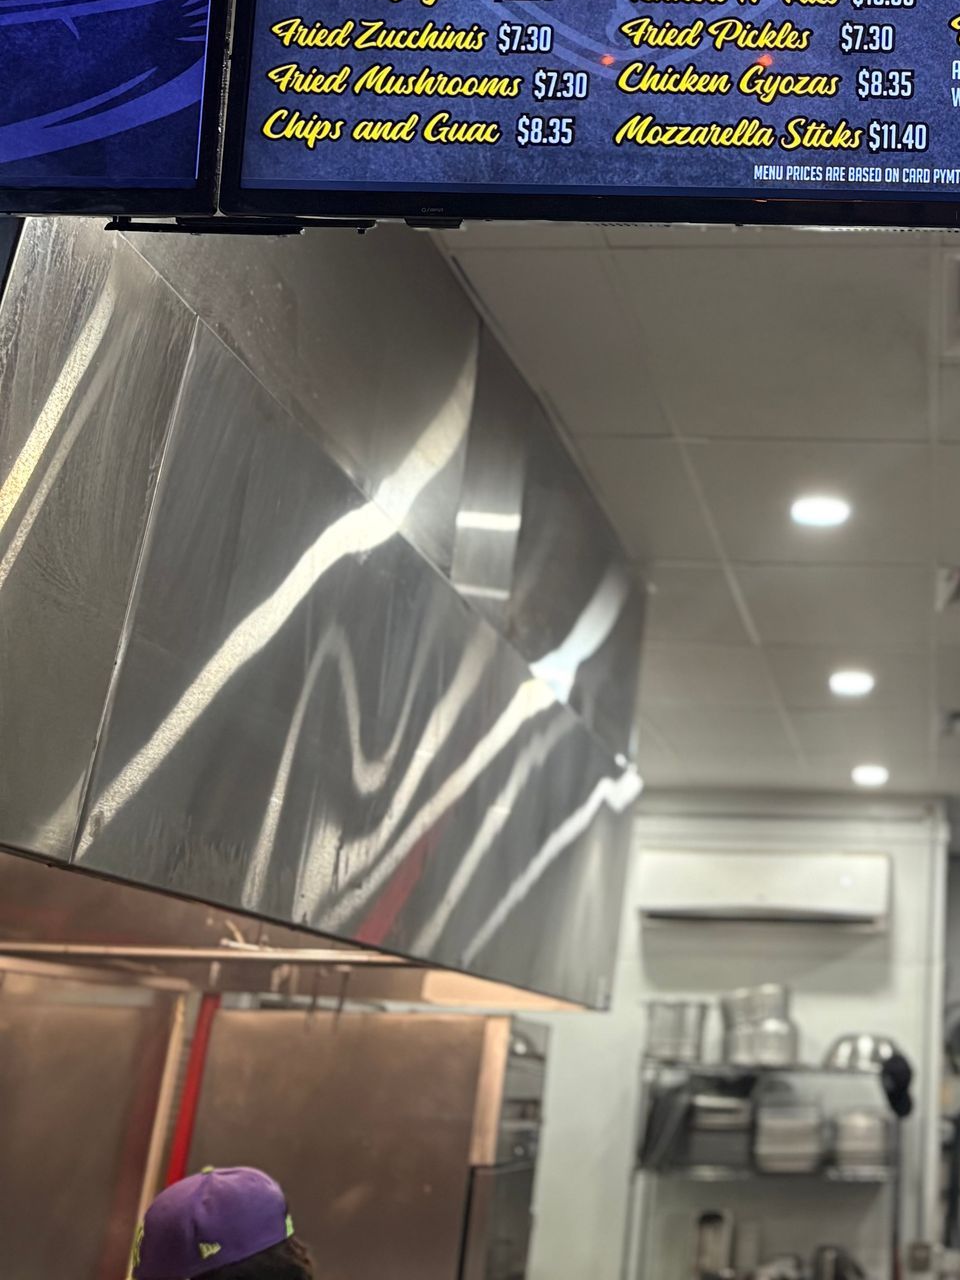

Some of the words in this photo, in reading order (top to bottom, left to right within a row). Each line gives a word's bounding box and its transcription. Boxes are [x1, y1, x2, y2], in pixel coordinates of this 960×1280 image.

[621, 18, 704, 47] Fried
[707, 20, 810, 49] Pickles
[841, 22, 893, 52] $7.30
[618, 63, 729, 93] Chicken
[739, 64, 837, 103] Gyozas
[858, 68, 912, 98] $8.35
[262, 109, 344, 148] Chips
[352, 114, 419, 141] and
[423, 112, 497, 143] Guac
[517, 114, 573, 146] $8.35
[754, 164, 784, 180] MENU
[786, 165, 823, 181] PRICES
[825, 166, 846, 182] ARE
[848, 166, 882, 182] BASED
[884, 167, 900, 183] ON
[902, 168, 931, 184] CARD
